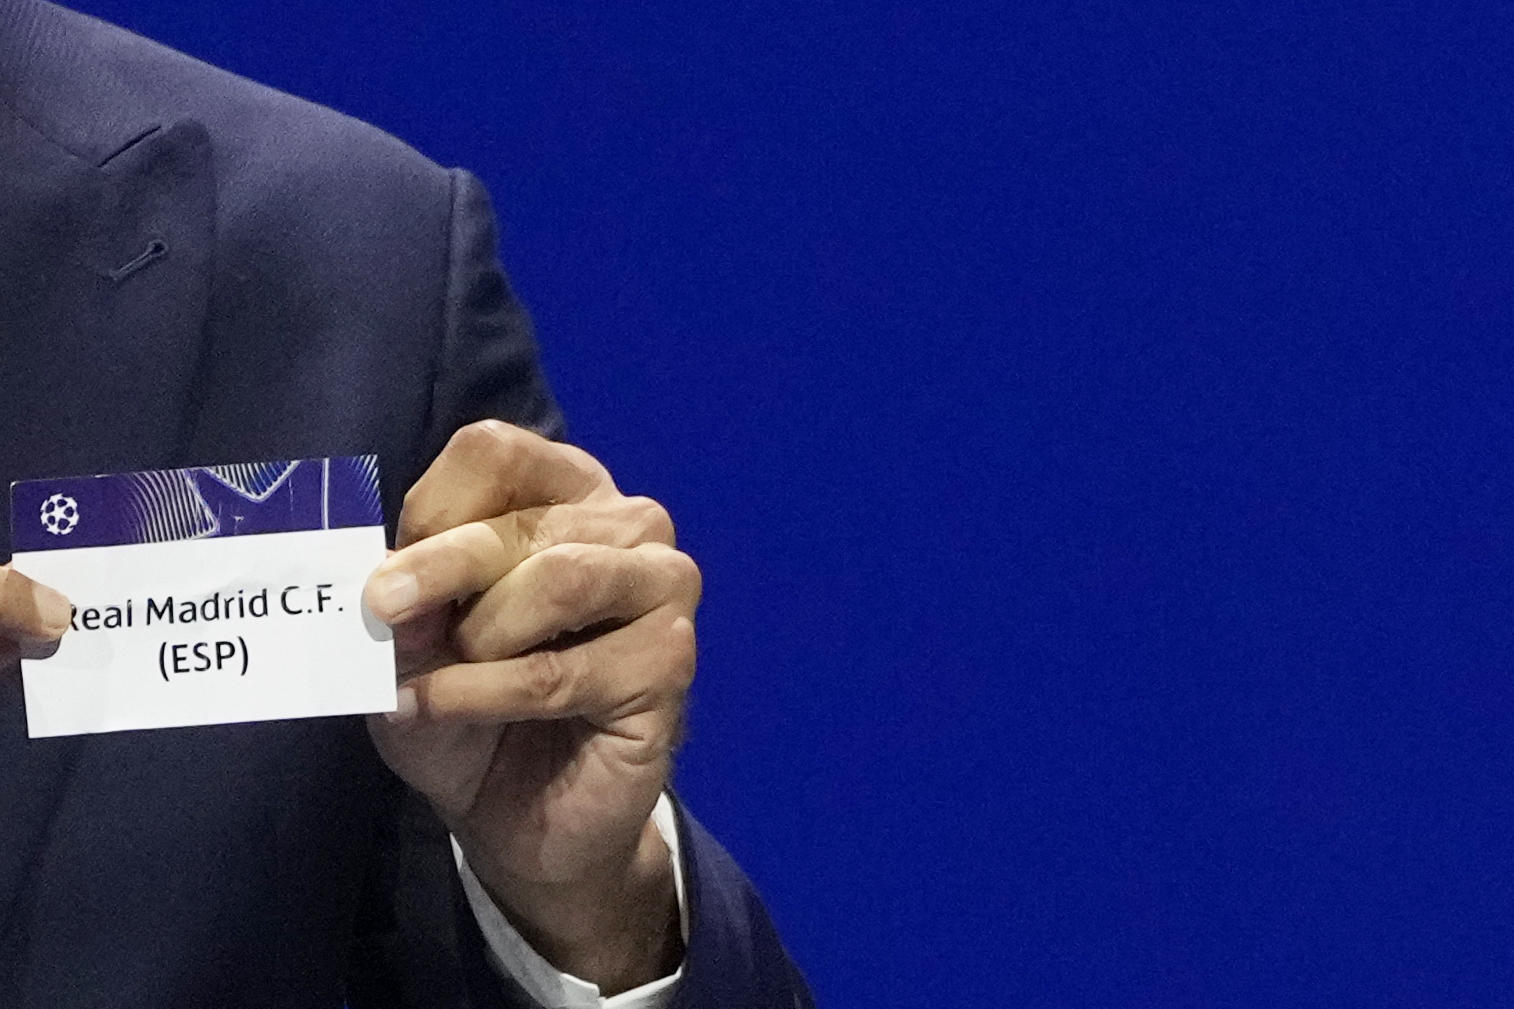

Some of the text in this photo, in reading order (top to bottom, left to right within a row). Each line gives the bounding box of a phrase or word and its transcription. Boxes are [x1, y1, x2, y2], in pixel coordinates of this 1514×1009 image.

[146, 588, 269, 626] Madrid
[280, 583, 344, 616] C.F.
[159, 636, 249, 682] (ESP)
